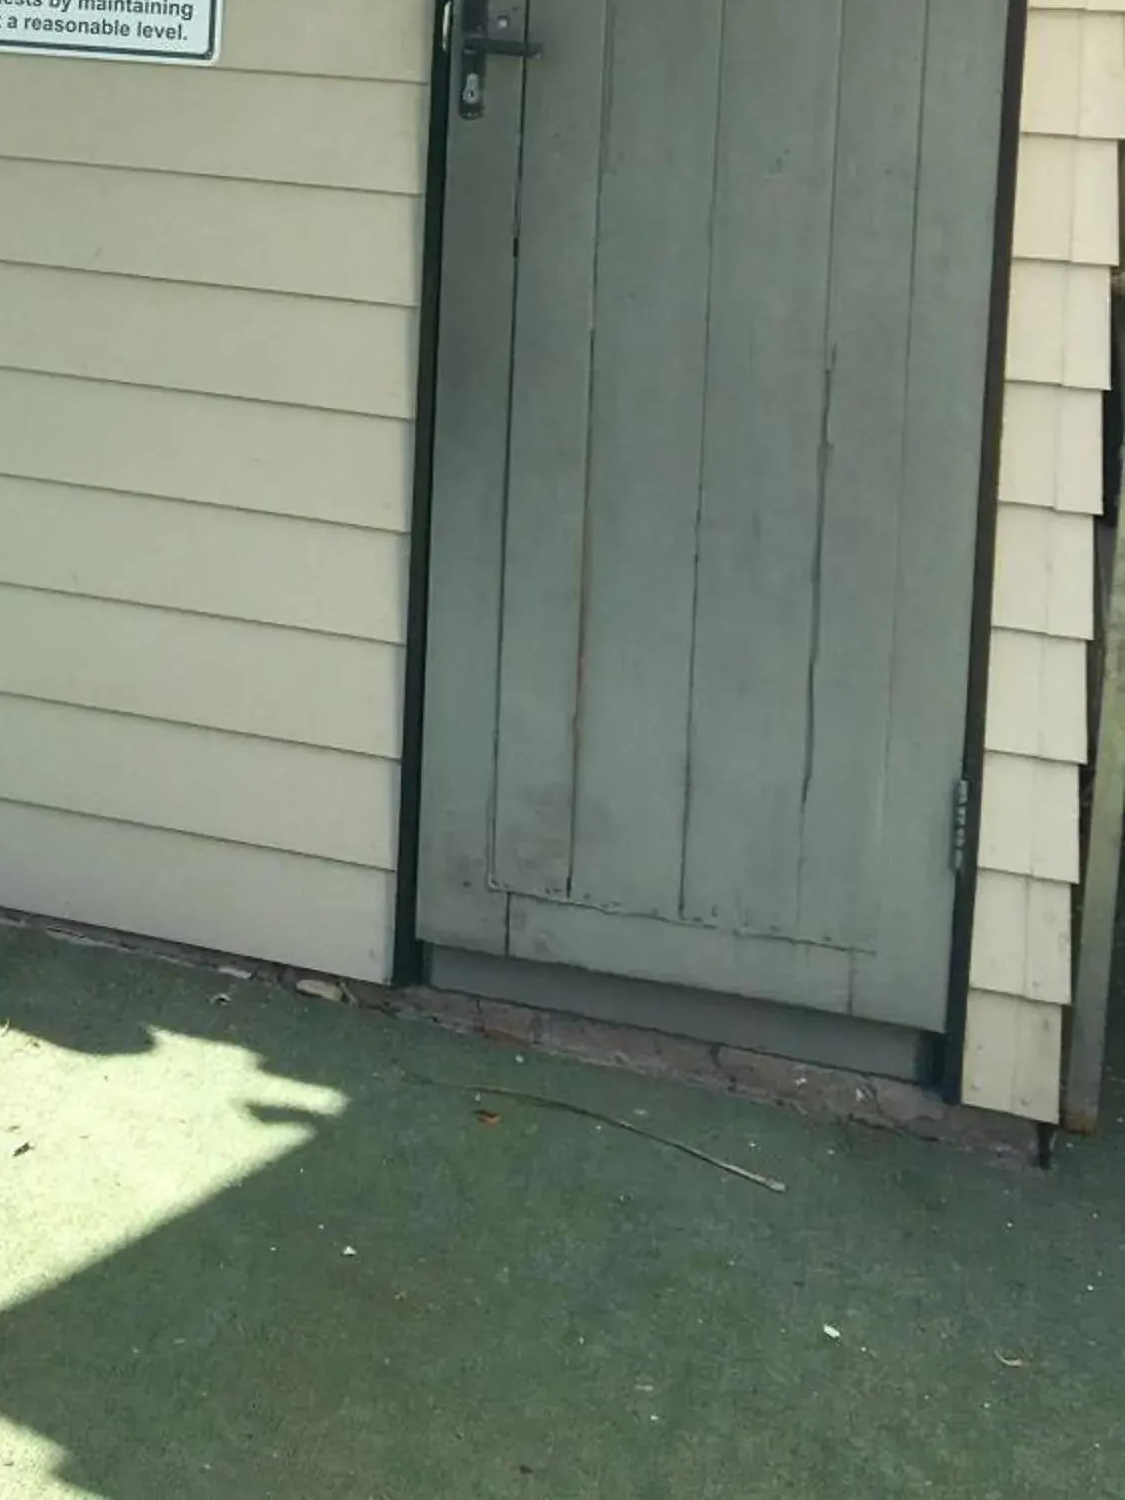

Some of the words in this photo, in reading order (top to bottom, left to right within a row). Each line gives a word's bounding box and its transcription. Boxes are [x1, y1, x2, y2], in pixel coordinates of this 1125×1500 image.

[8, 16, 19, 29] a
[24, 14, 130, 37] reasonable
[137, 20, 188, 41] level.
